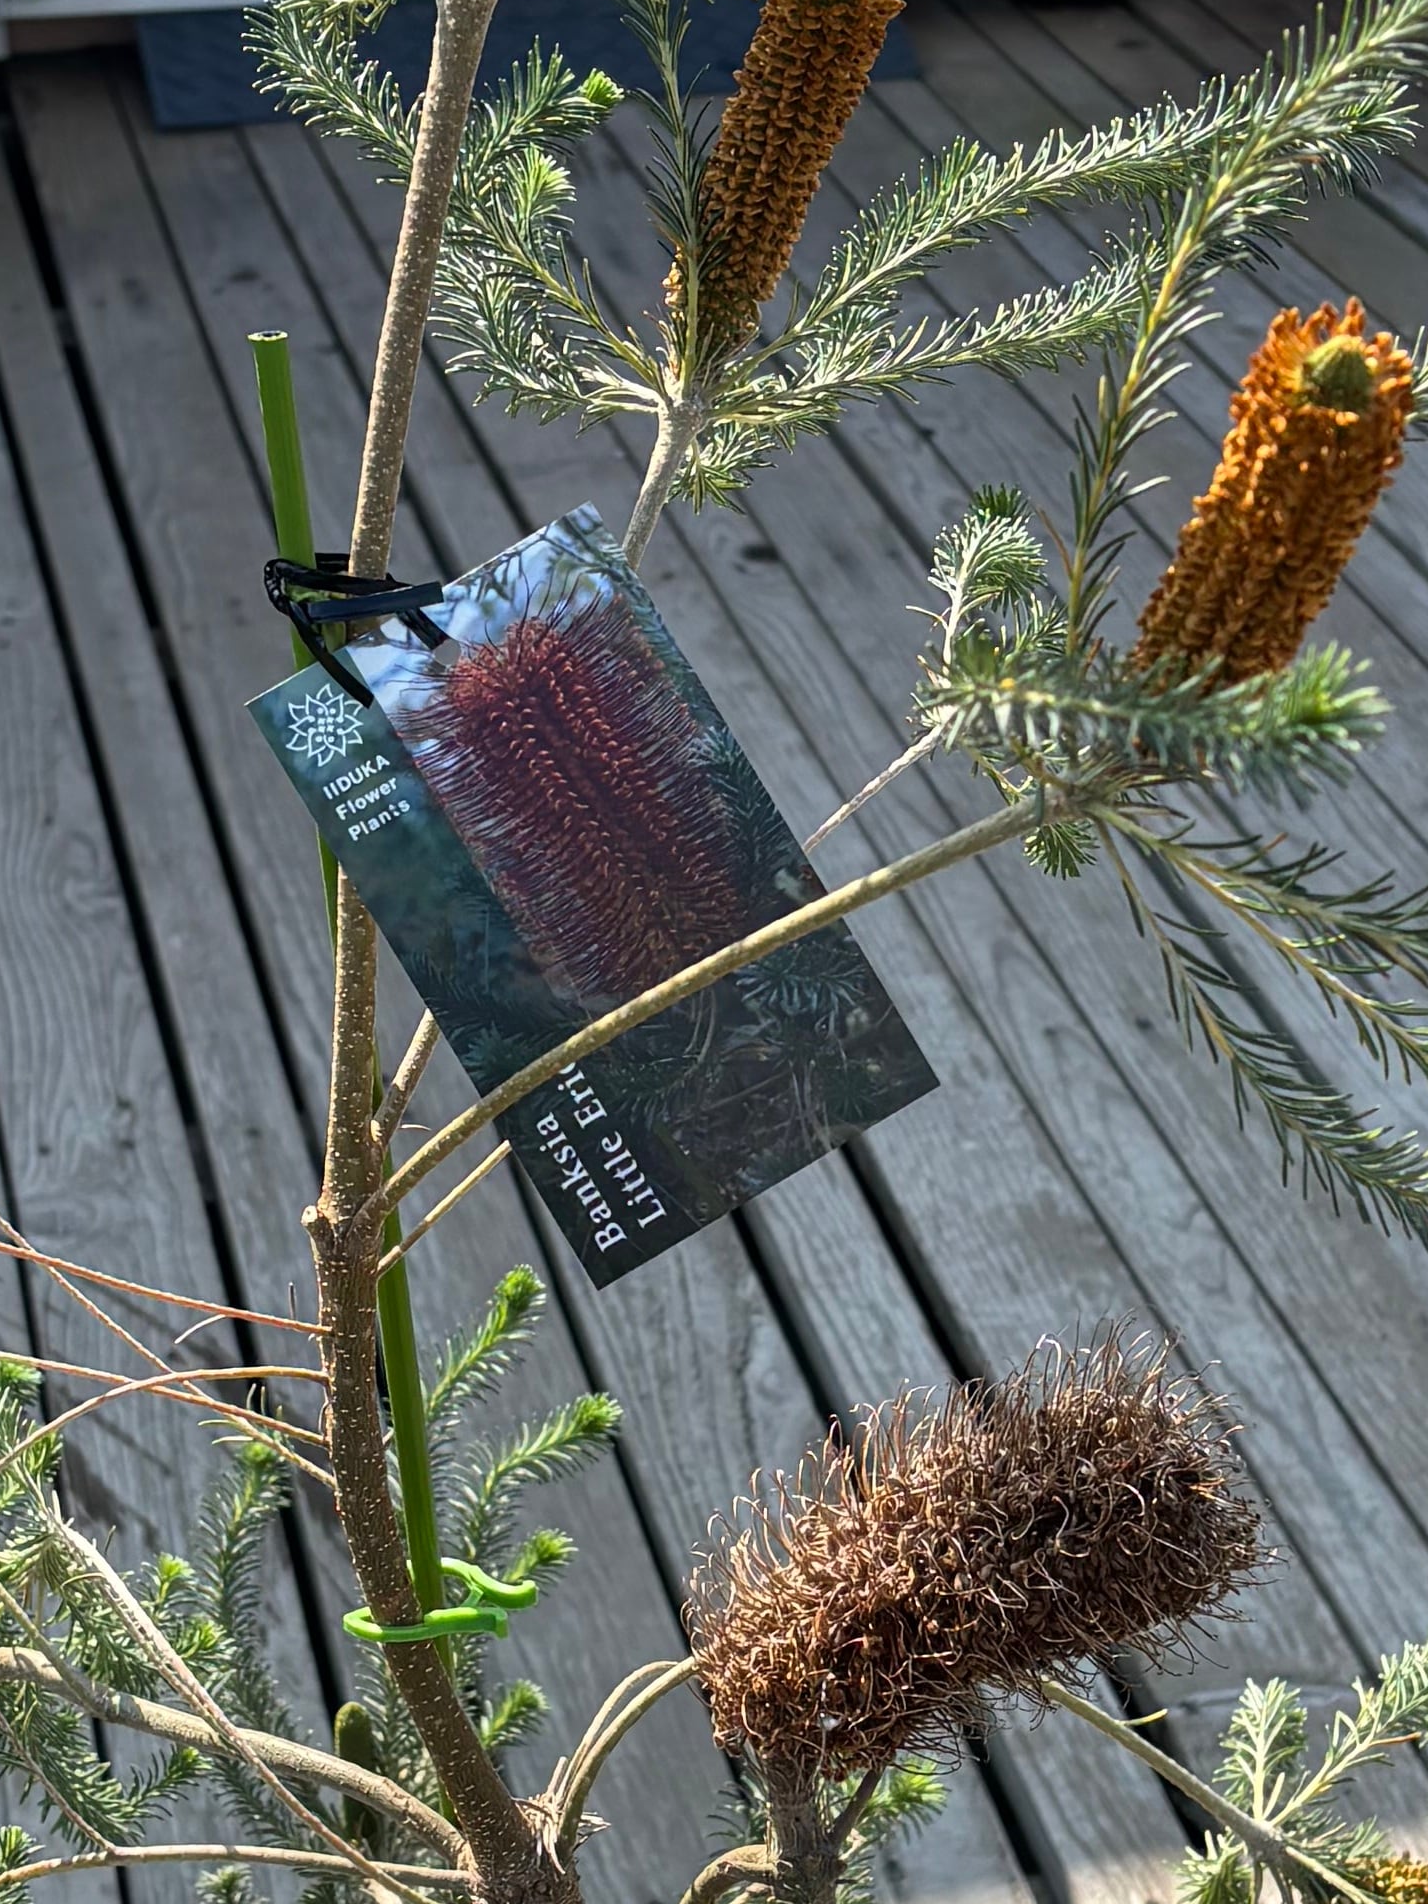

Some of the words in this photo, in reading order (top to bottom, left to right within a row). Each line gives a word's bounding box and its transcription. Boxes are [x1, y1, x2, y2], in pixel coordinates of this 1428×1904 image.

[323, 755, 390, 800] IIDUKA
[335, 777, 397, 820] Flower
[348, 800, 410, 841] Plants
[536, 1112, 627, 1253] Banksia
[601, 1131, 667, 1229] Little
